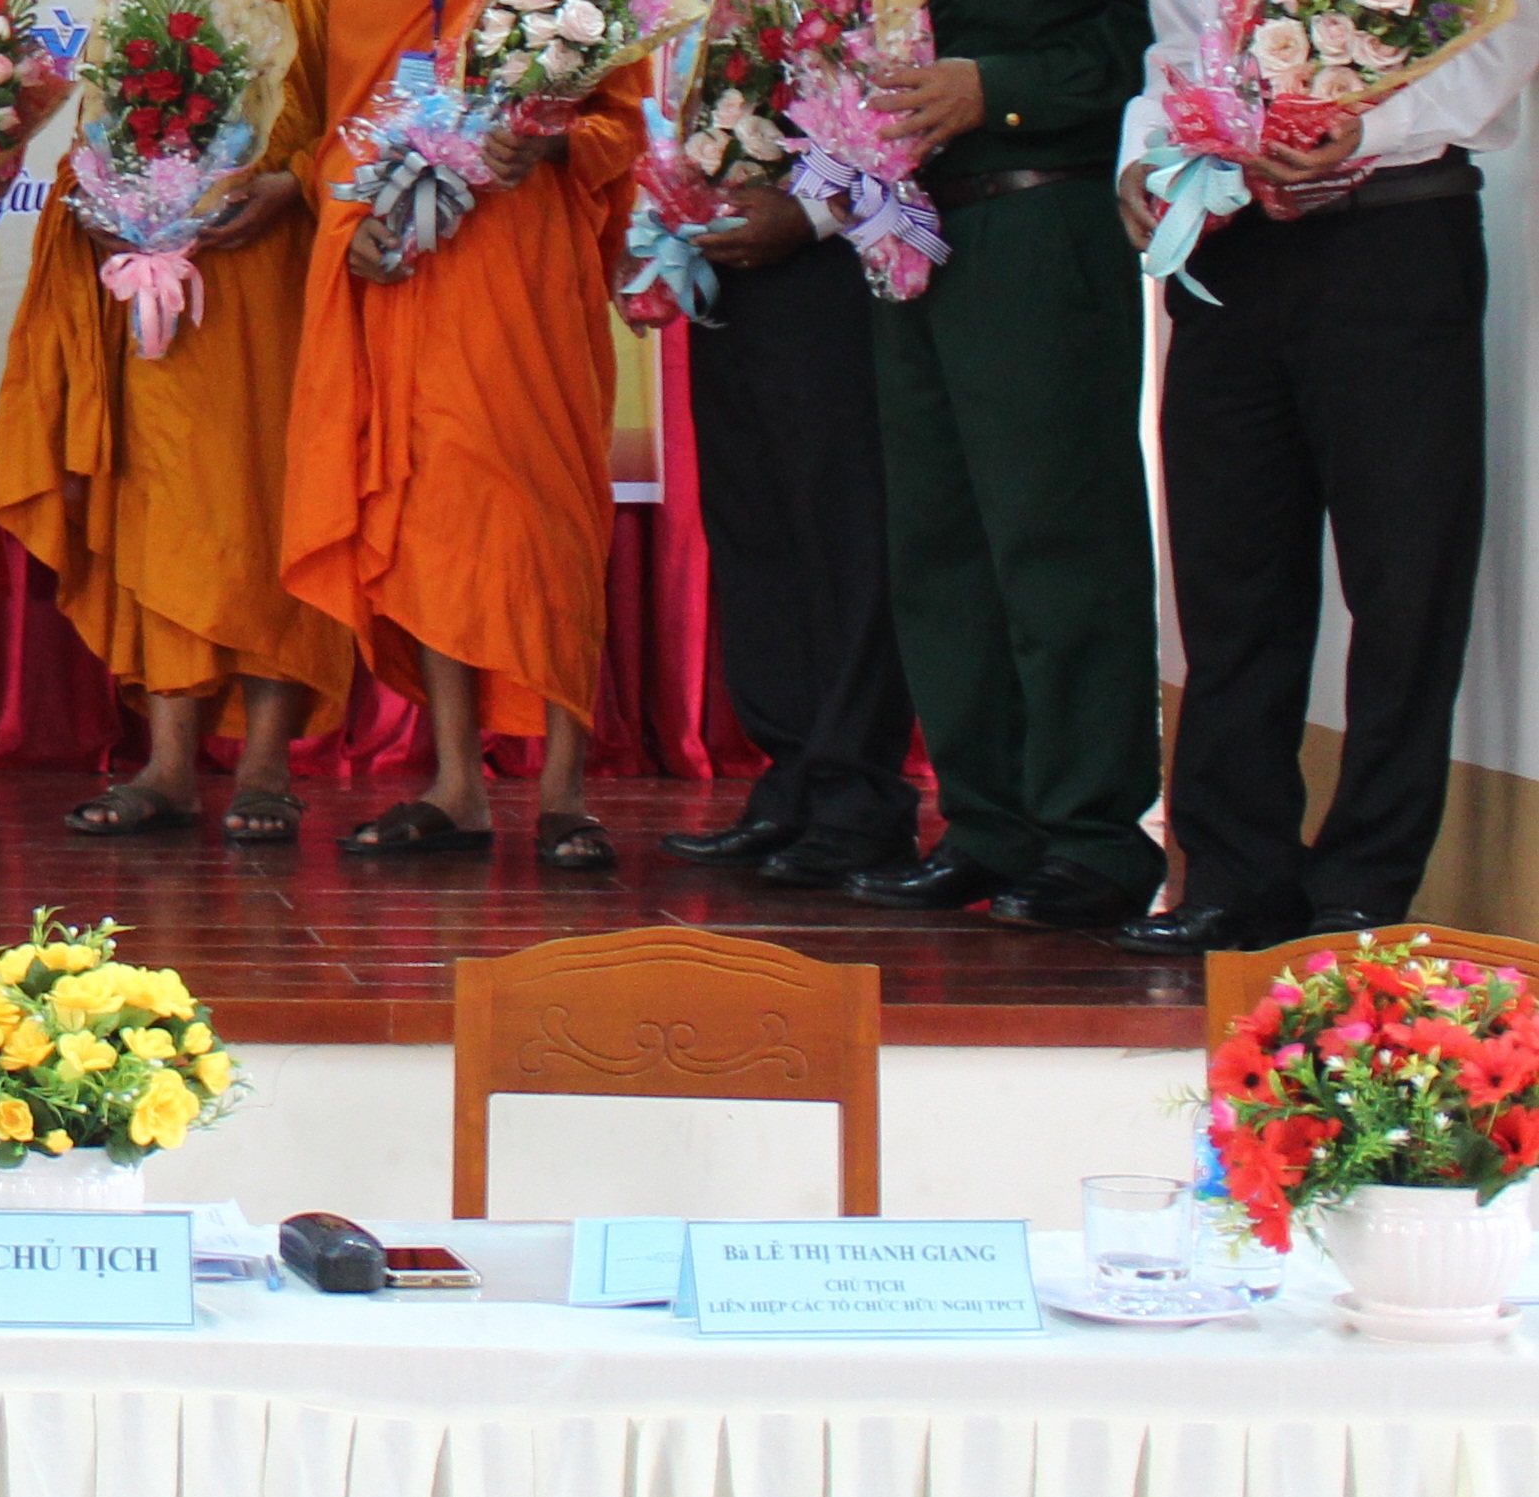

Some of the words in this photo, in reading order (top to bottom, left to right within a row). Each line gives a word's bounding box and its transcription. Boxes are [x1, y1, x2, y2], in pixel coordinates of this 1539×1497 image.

[72, 1245, 160, 1278] TỊCH
[789, 1244, 829, 1265] THỊ
[835, 1244, 916, 1262] THANH
[922, 1244, 997, 1262] GIANG
